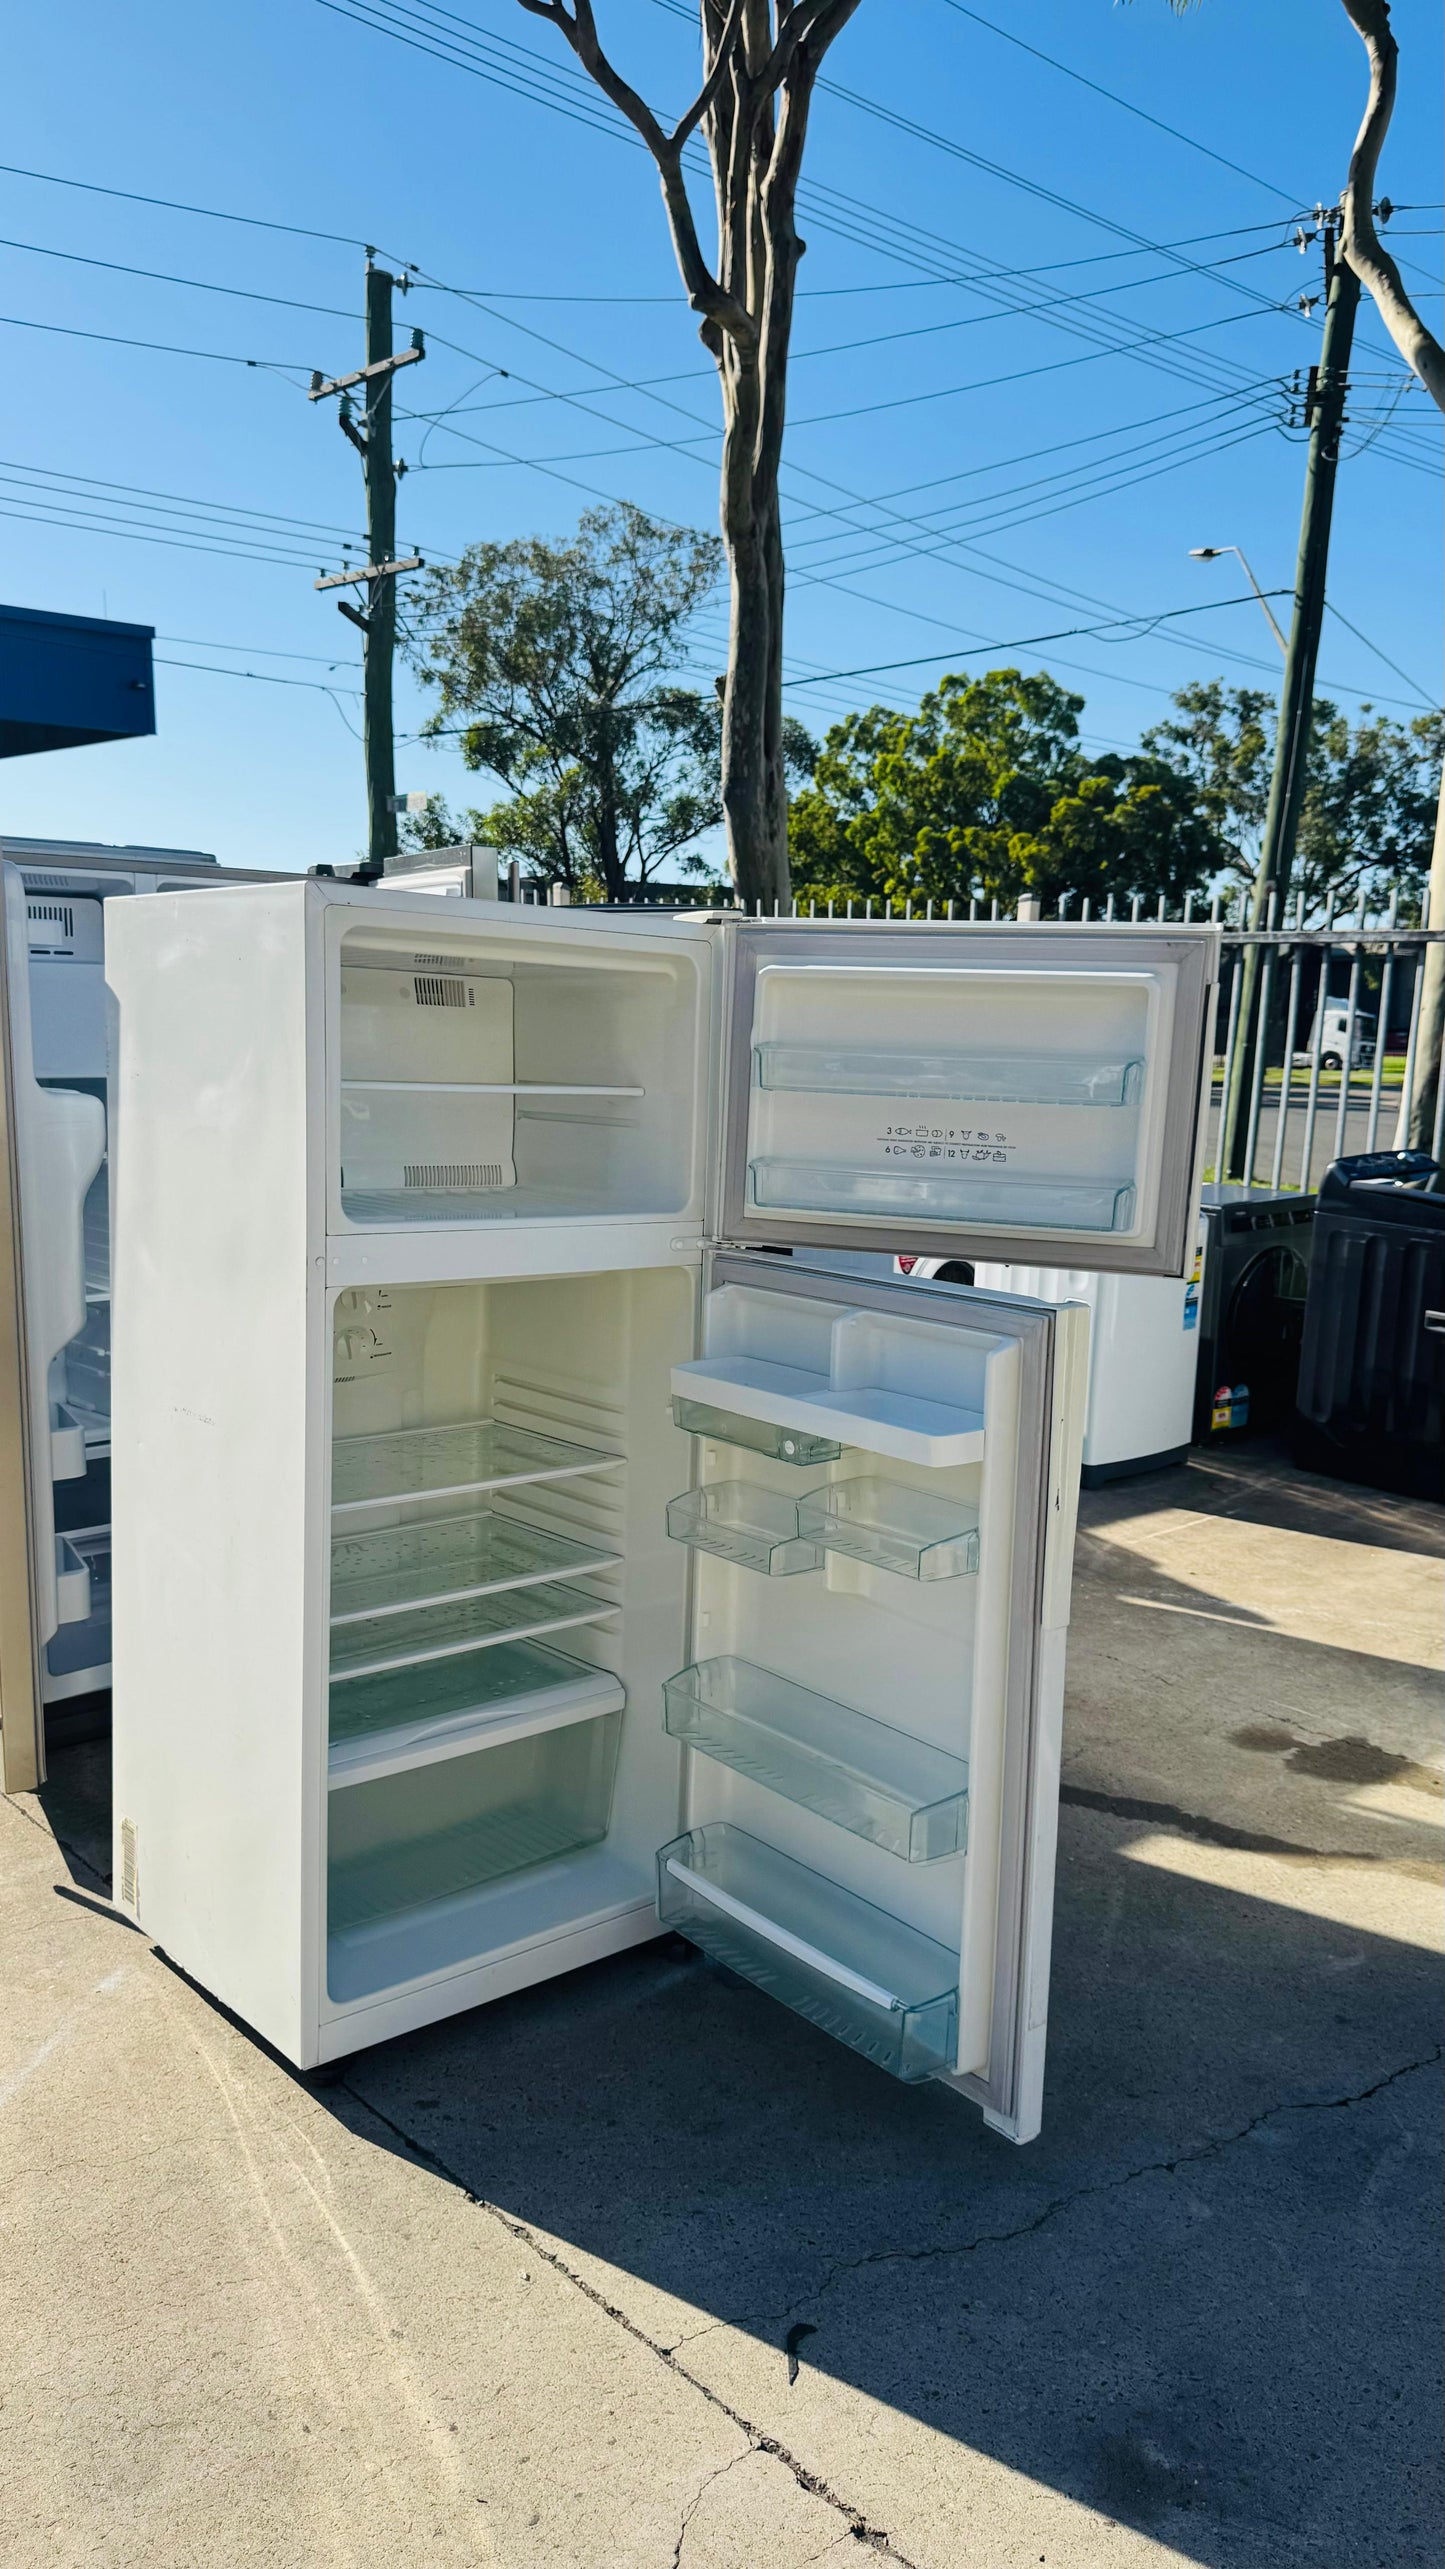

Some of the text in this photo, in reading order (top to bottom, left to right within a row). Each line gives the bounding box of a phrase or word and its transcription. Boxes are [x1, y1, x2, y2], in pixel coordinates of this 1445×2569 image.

[886, 1126, 955, 1138] 3 9
[885, 1145, 956, 1158] 6 12
